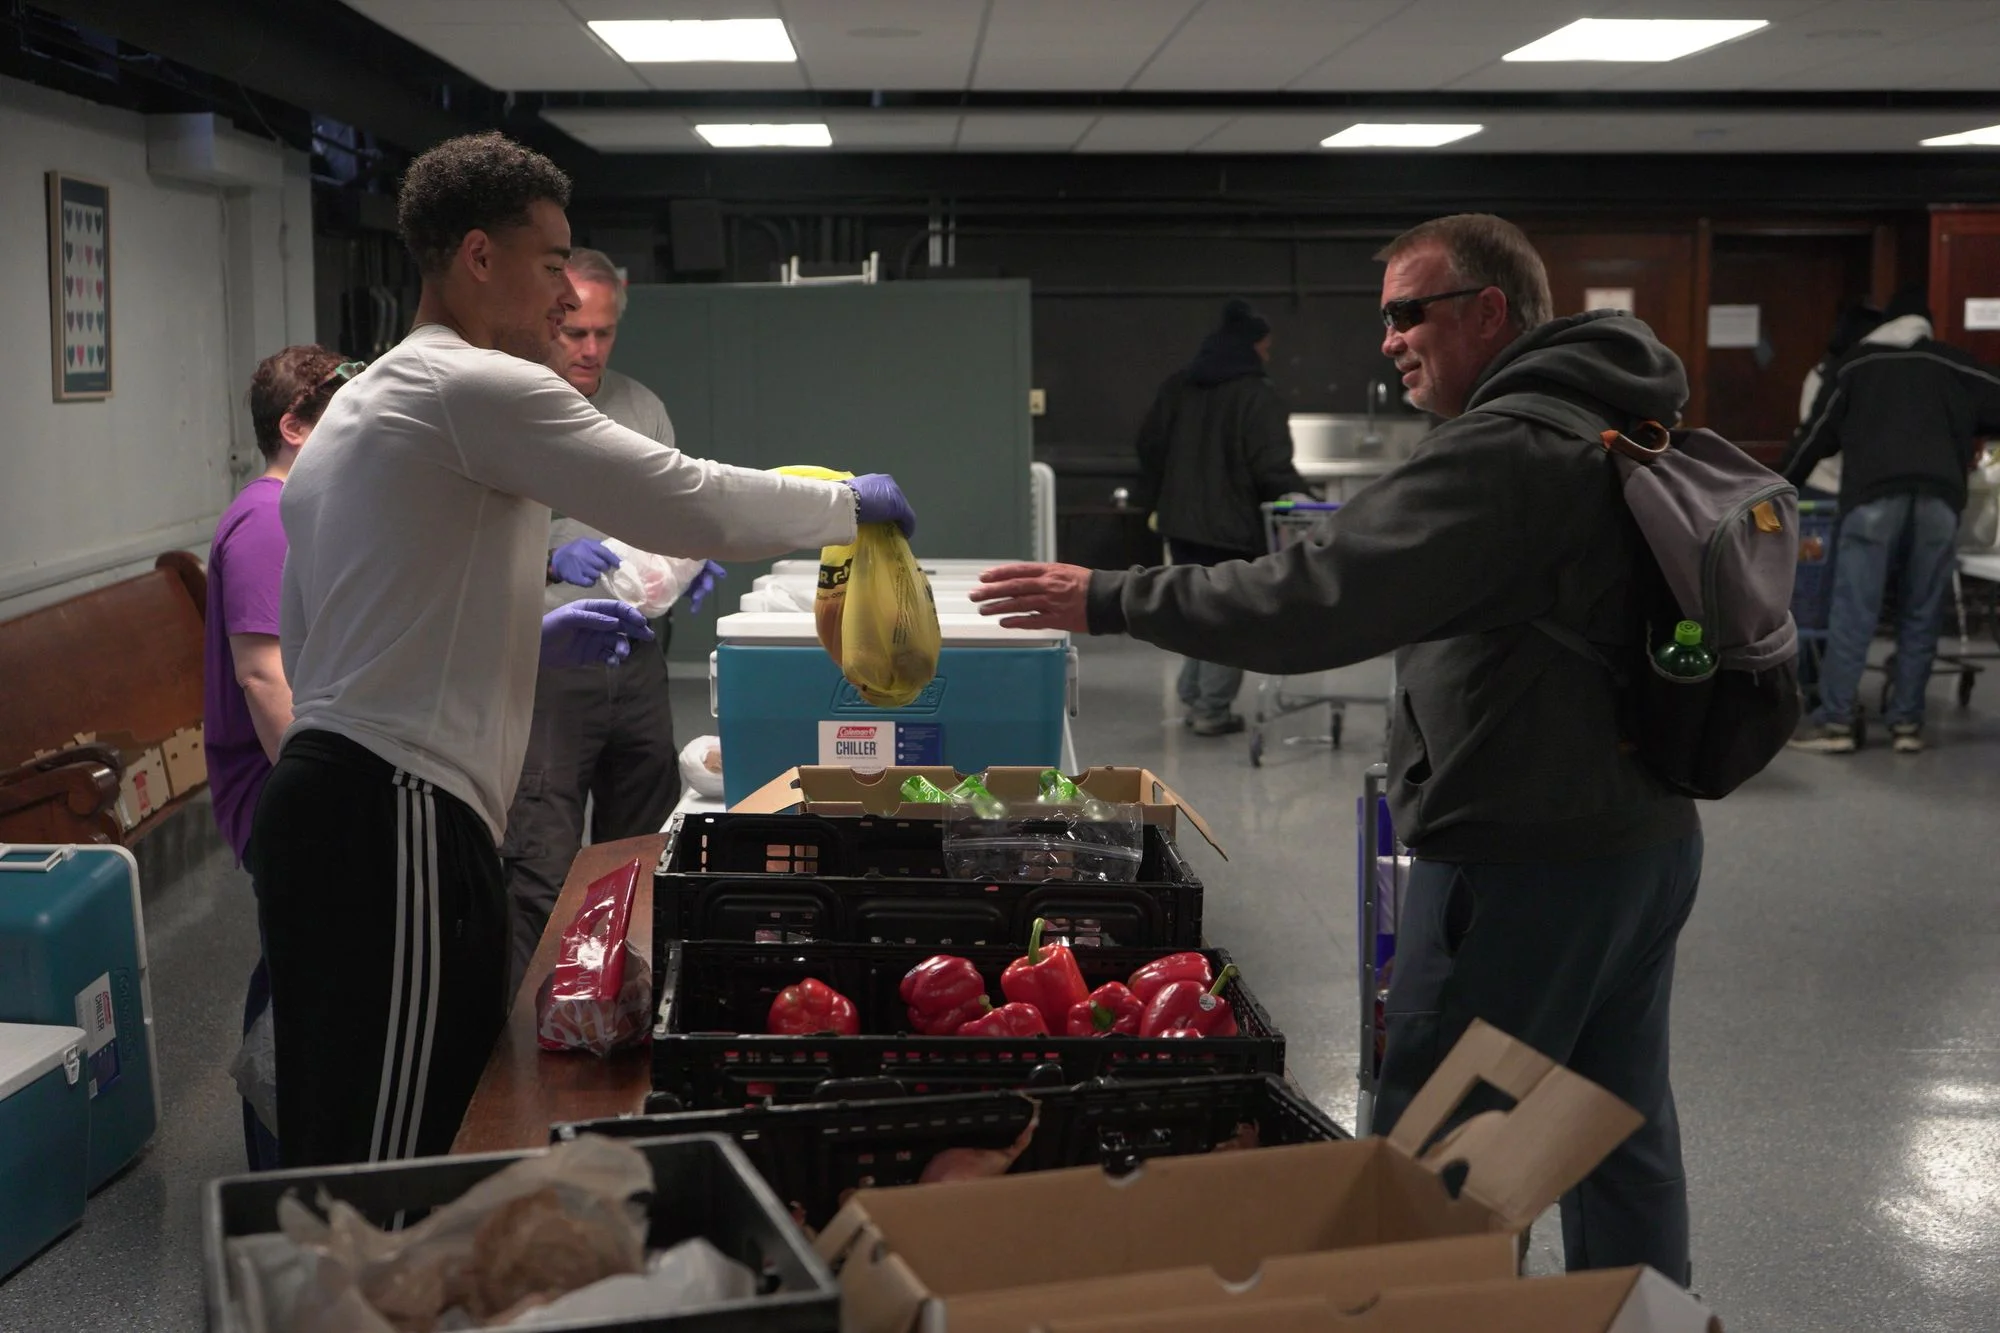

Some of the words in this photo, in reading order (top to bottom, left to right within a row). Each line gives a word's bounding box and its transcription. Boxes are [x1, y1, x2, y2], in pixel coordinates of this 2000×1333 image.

[839, 727, 871, 738] Coleman
[836, 741, 876, 755] CHILLER
[95, 993, 105, 1032] CHILLER
